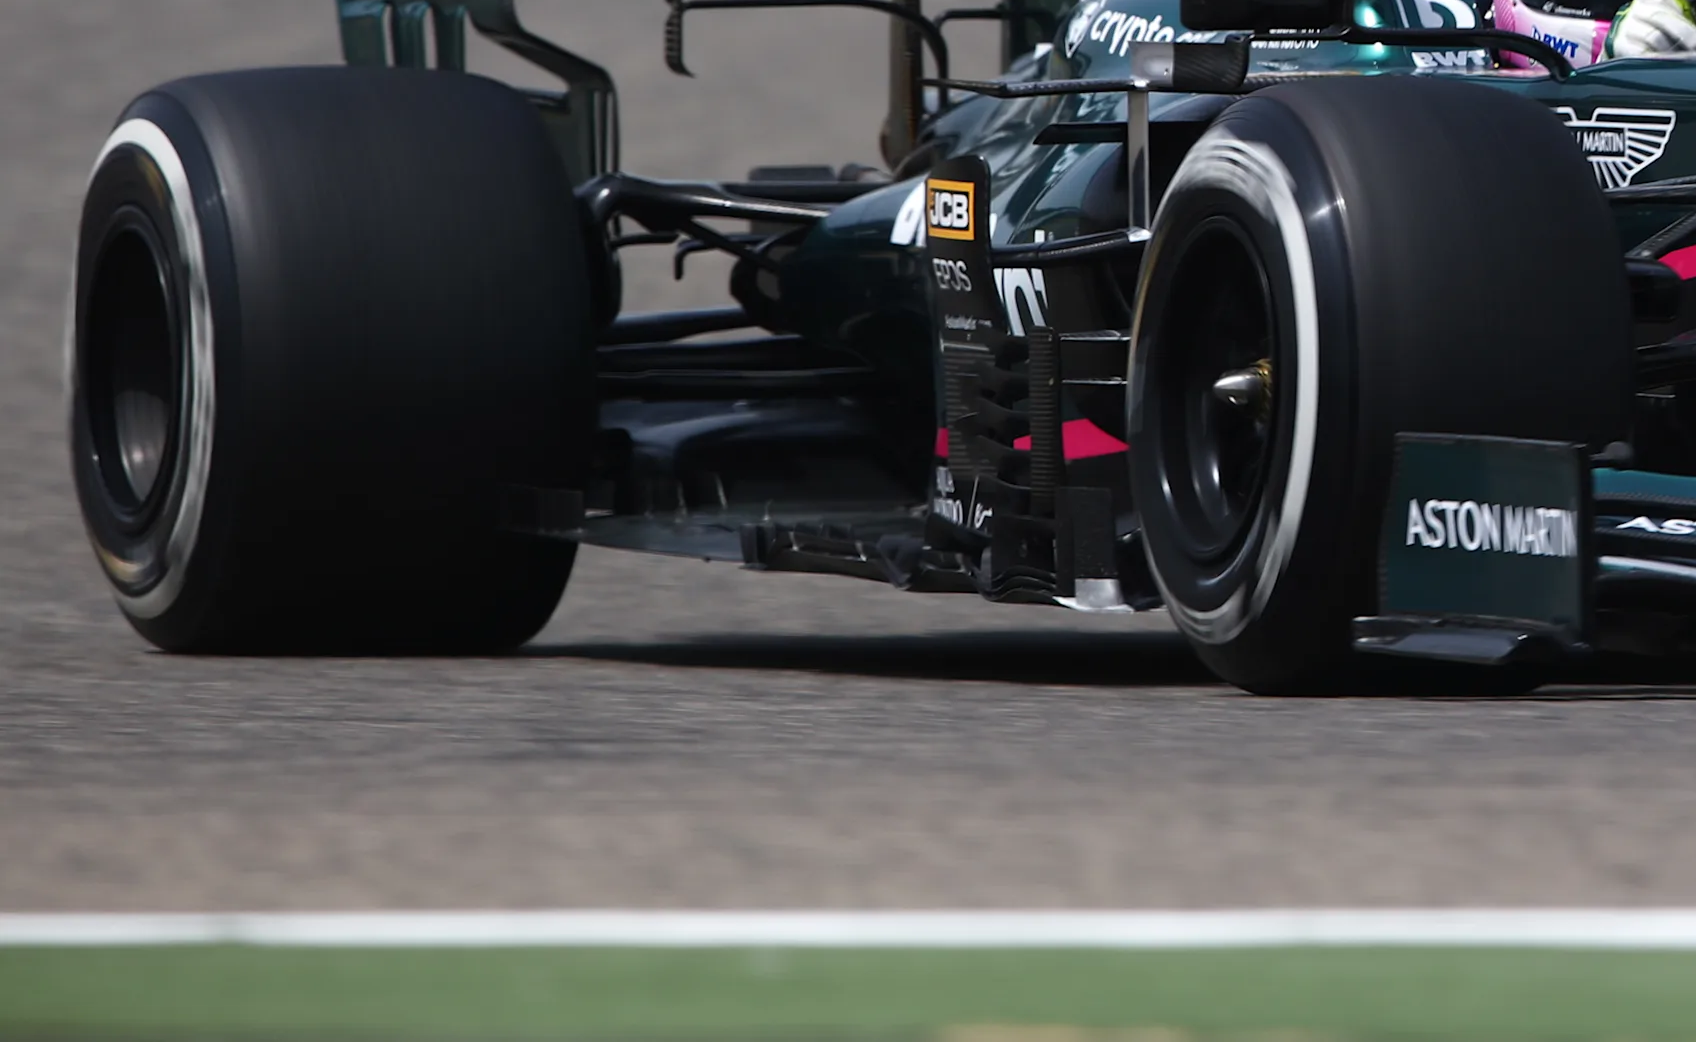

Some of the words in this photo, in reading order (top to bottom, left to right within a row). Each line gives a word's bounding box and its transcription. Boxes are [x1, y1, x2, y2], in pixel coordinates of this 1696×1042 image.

[1090, 9, 1217, 57] crypto
[1542, 32, 1580, 59] BWT
[1411, 49, 1486, 68] BWT
[1582, 130, 1625, 153] MARTIN
[930, 191, 969, 229] JCB
[932, 257, 973, 293] EPOS
[1405, 497, 1501, 551] ASTON
[1503, 505, 1578, 558] MARTIN
